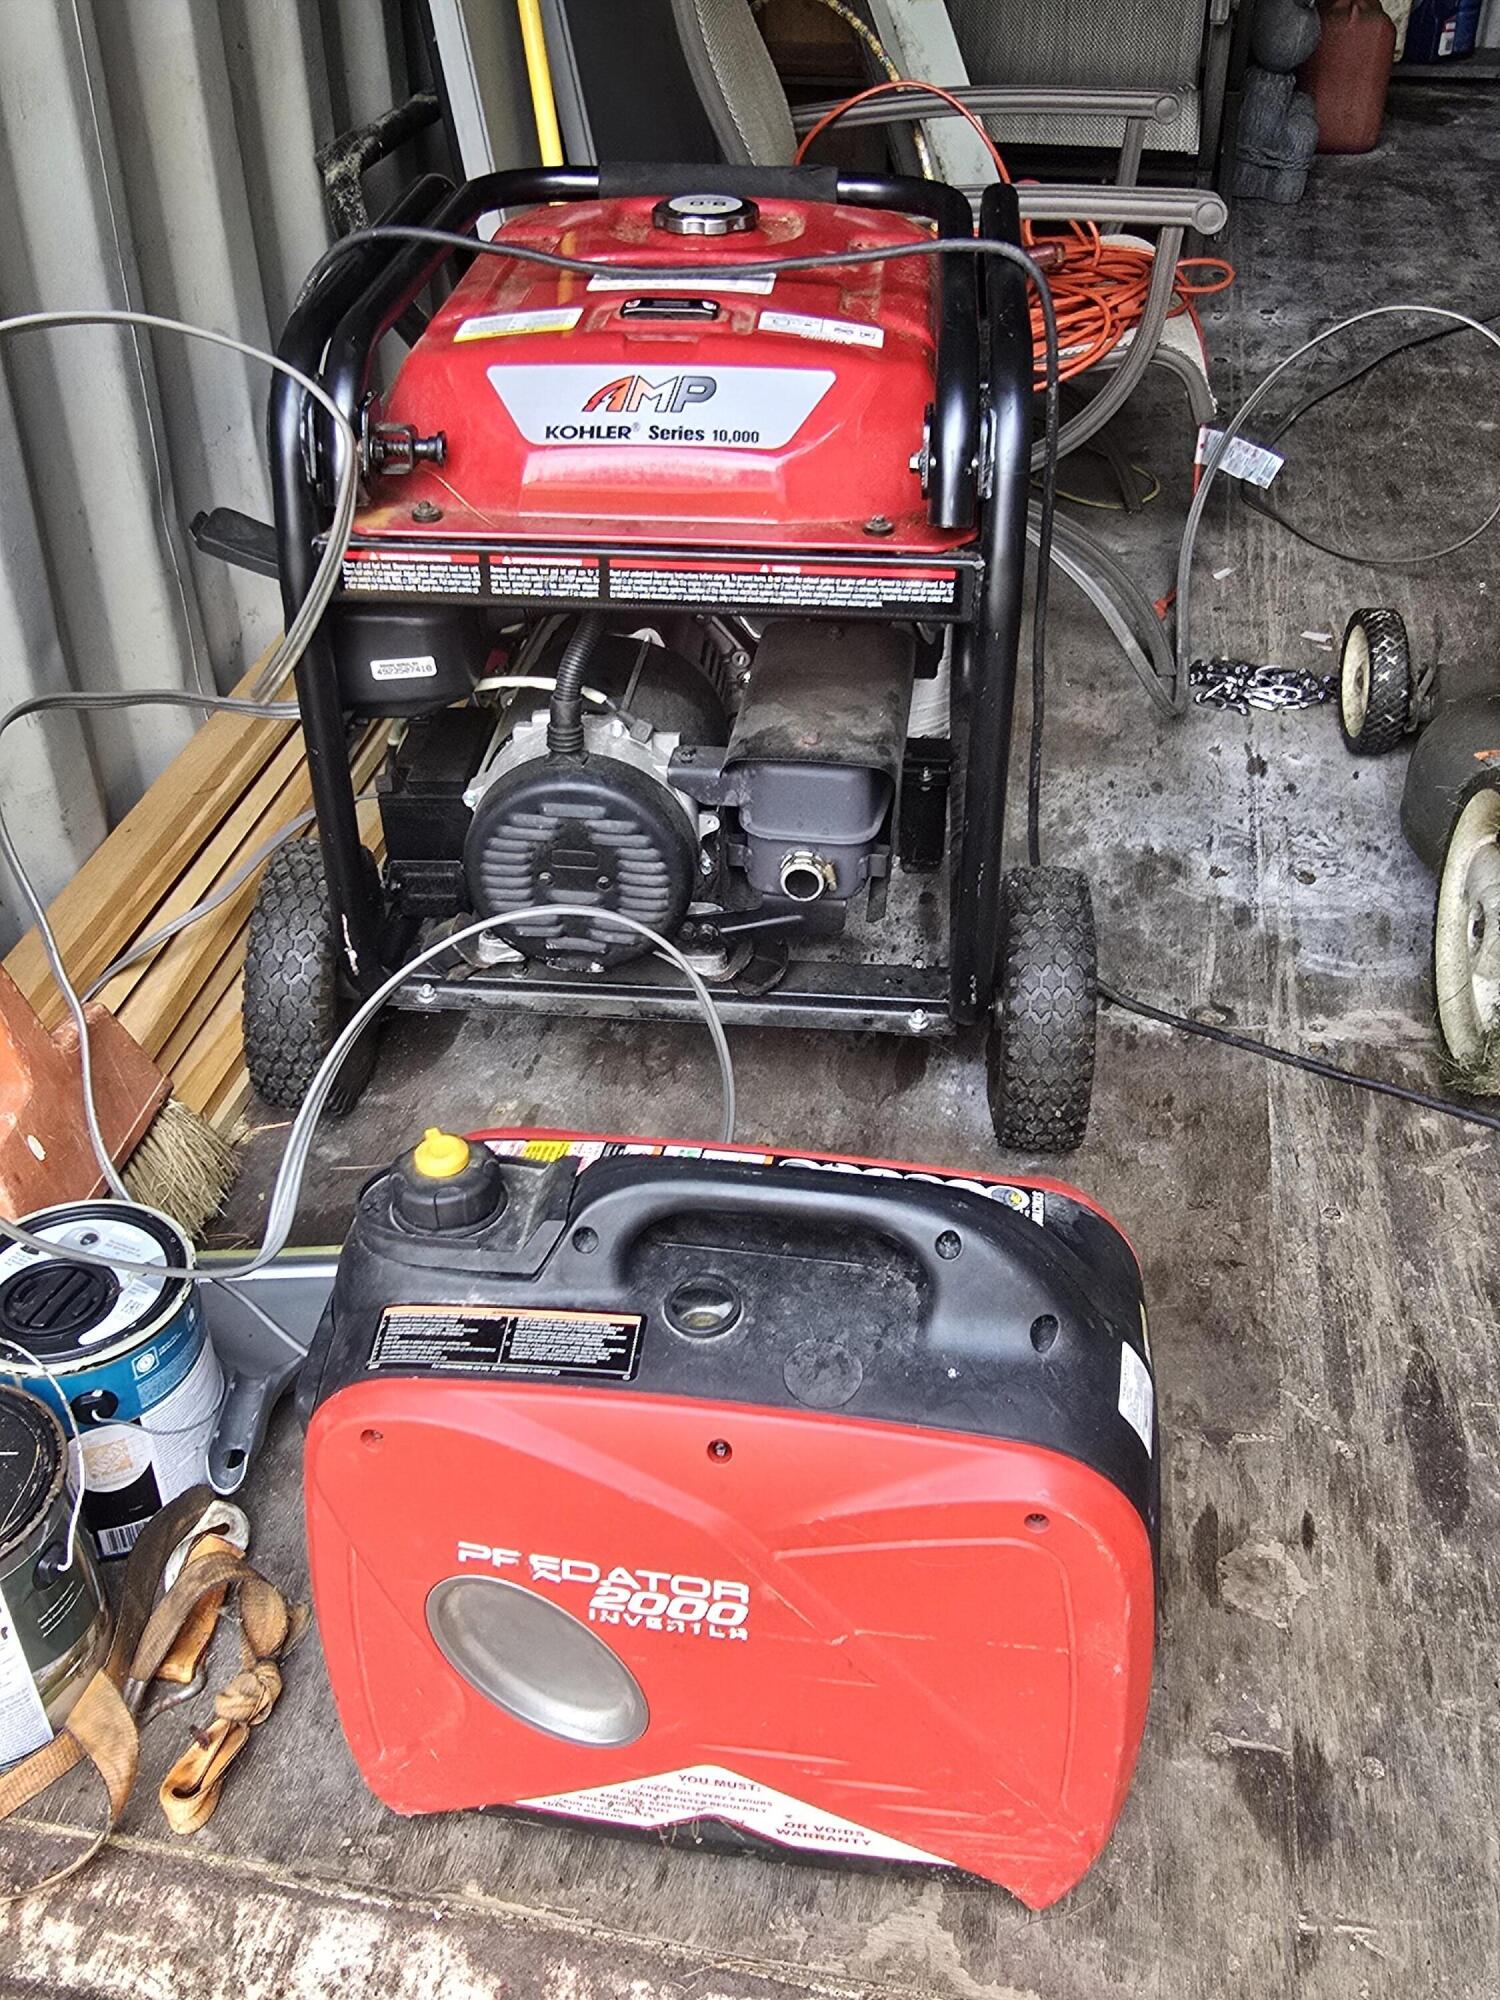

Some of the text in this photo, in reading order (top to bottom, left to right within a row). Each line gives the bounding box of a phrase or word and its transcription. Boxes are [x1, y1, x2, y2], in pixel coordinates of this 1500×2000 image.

[581, 374, 717, 413] AMP
[648, 424, 705, 442] Series
[711, 429, 760, 445] 10,000
[588, 1586, 750, 1628] 2000
[678, 1774, 761, 1792] YOU MUST:
[674, 1795, 707, 1806] FILTER
[709, 1801, 767, 1814] REGULARLY
[695, 1791, 728, 1801] EVERY
[738, 1797, 773, 1807] HOURS
[775, 1827, 872, 1846] WARRANTY
[784, 1821, 865, 1838] OR VOIDS
